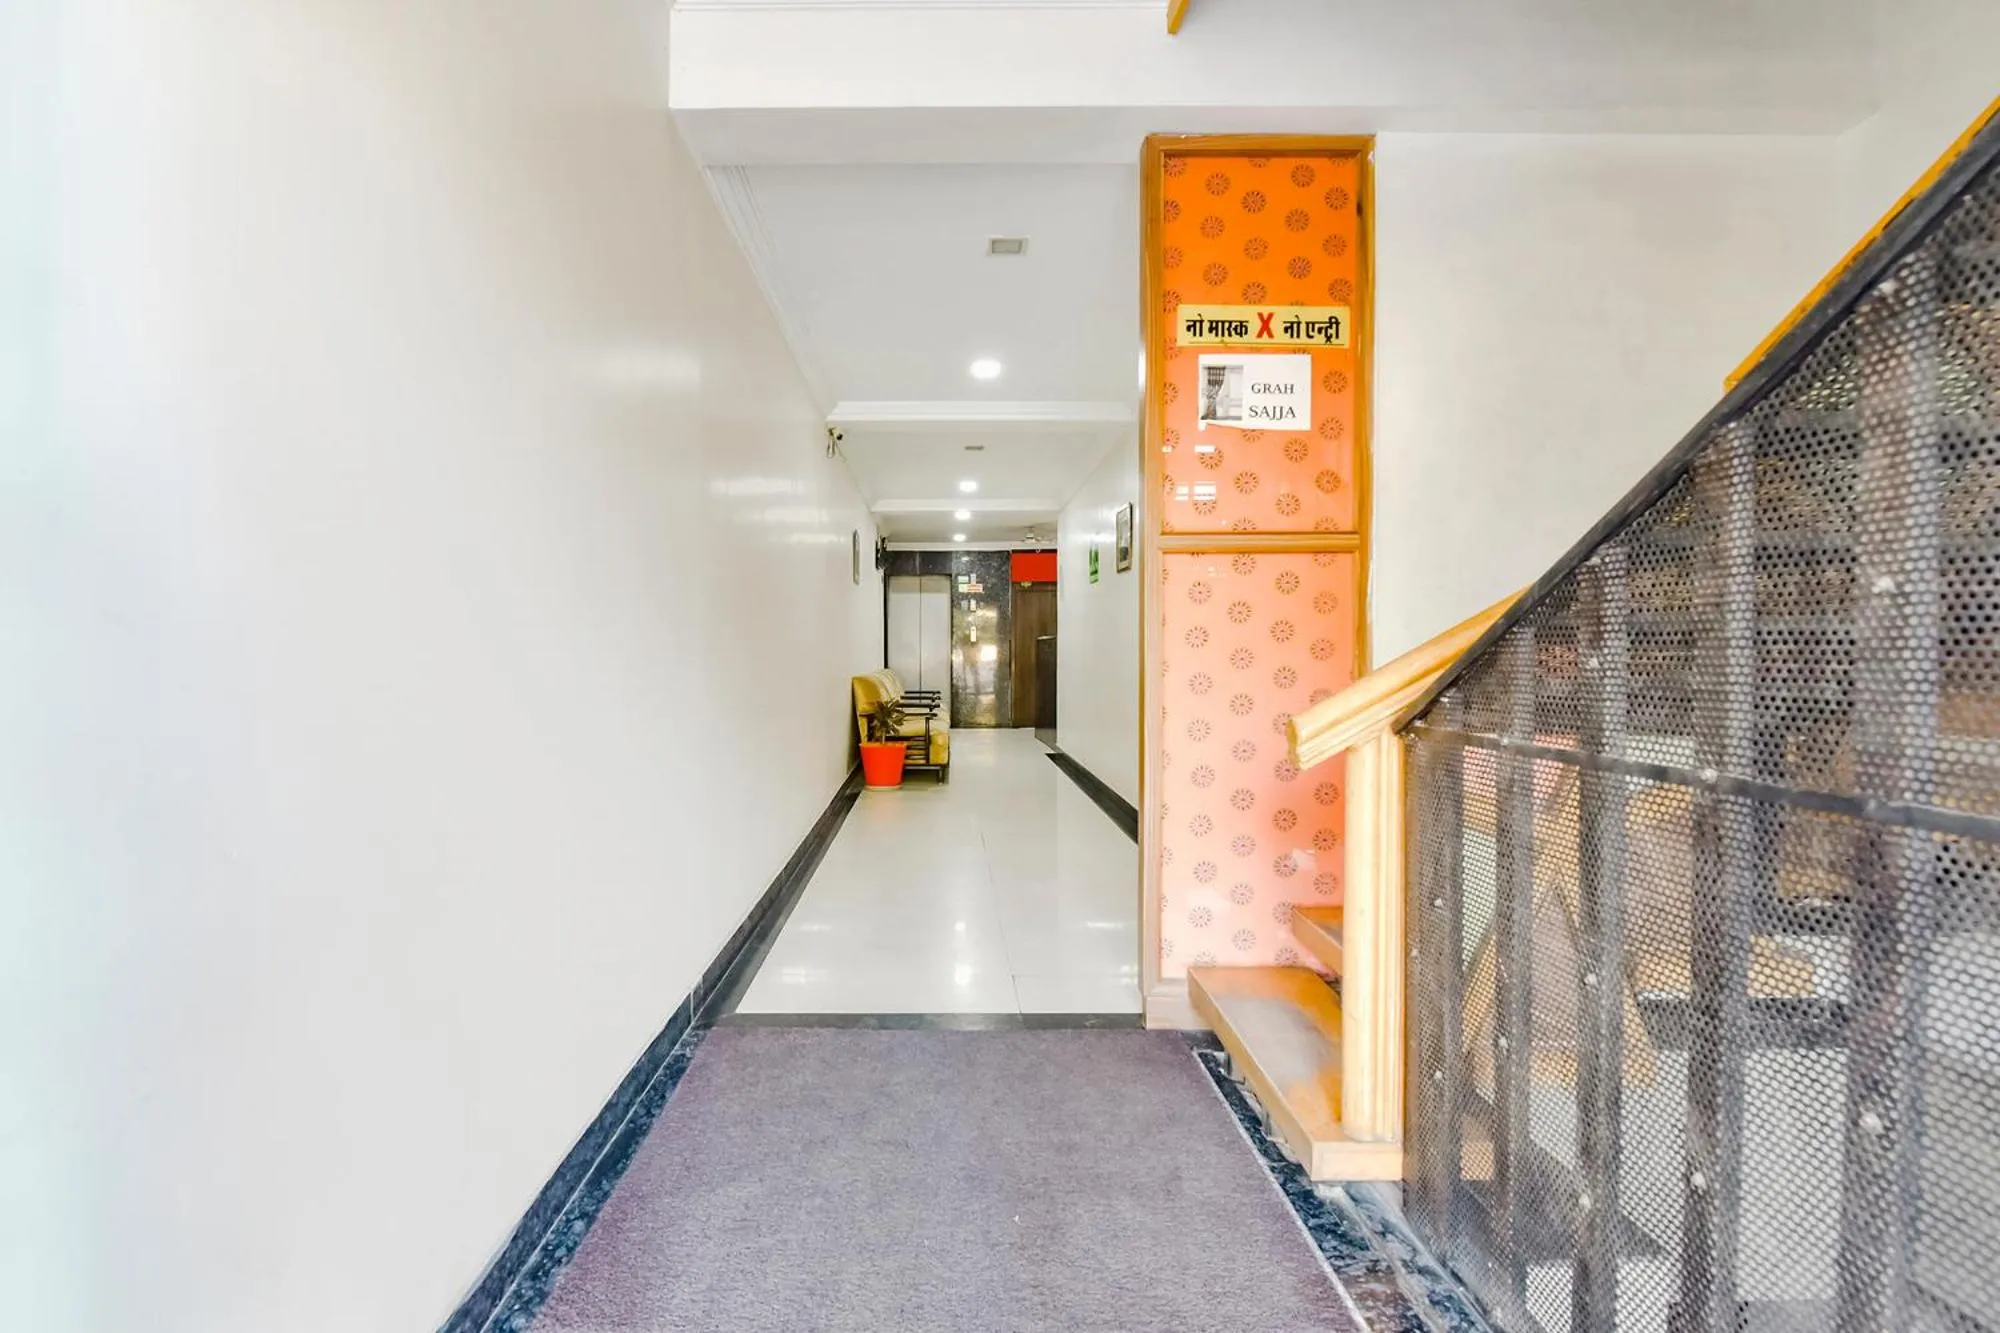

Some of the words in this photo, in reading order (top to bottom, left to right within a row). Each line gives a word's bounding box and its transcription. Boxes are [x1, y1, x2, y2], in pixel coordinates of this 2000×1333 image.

[1186, 313, 1204, 337] नो
[1207, 319, 1249, 338] मास्क
[1283, 315, 1301, 339] नो
[1305, 316, 1341, 344] एन्ट्री
[1251, 382, 1295, 394] GRAH
[1248, 405, 1297, 420] SAJJA
